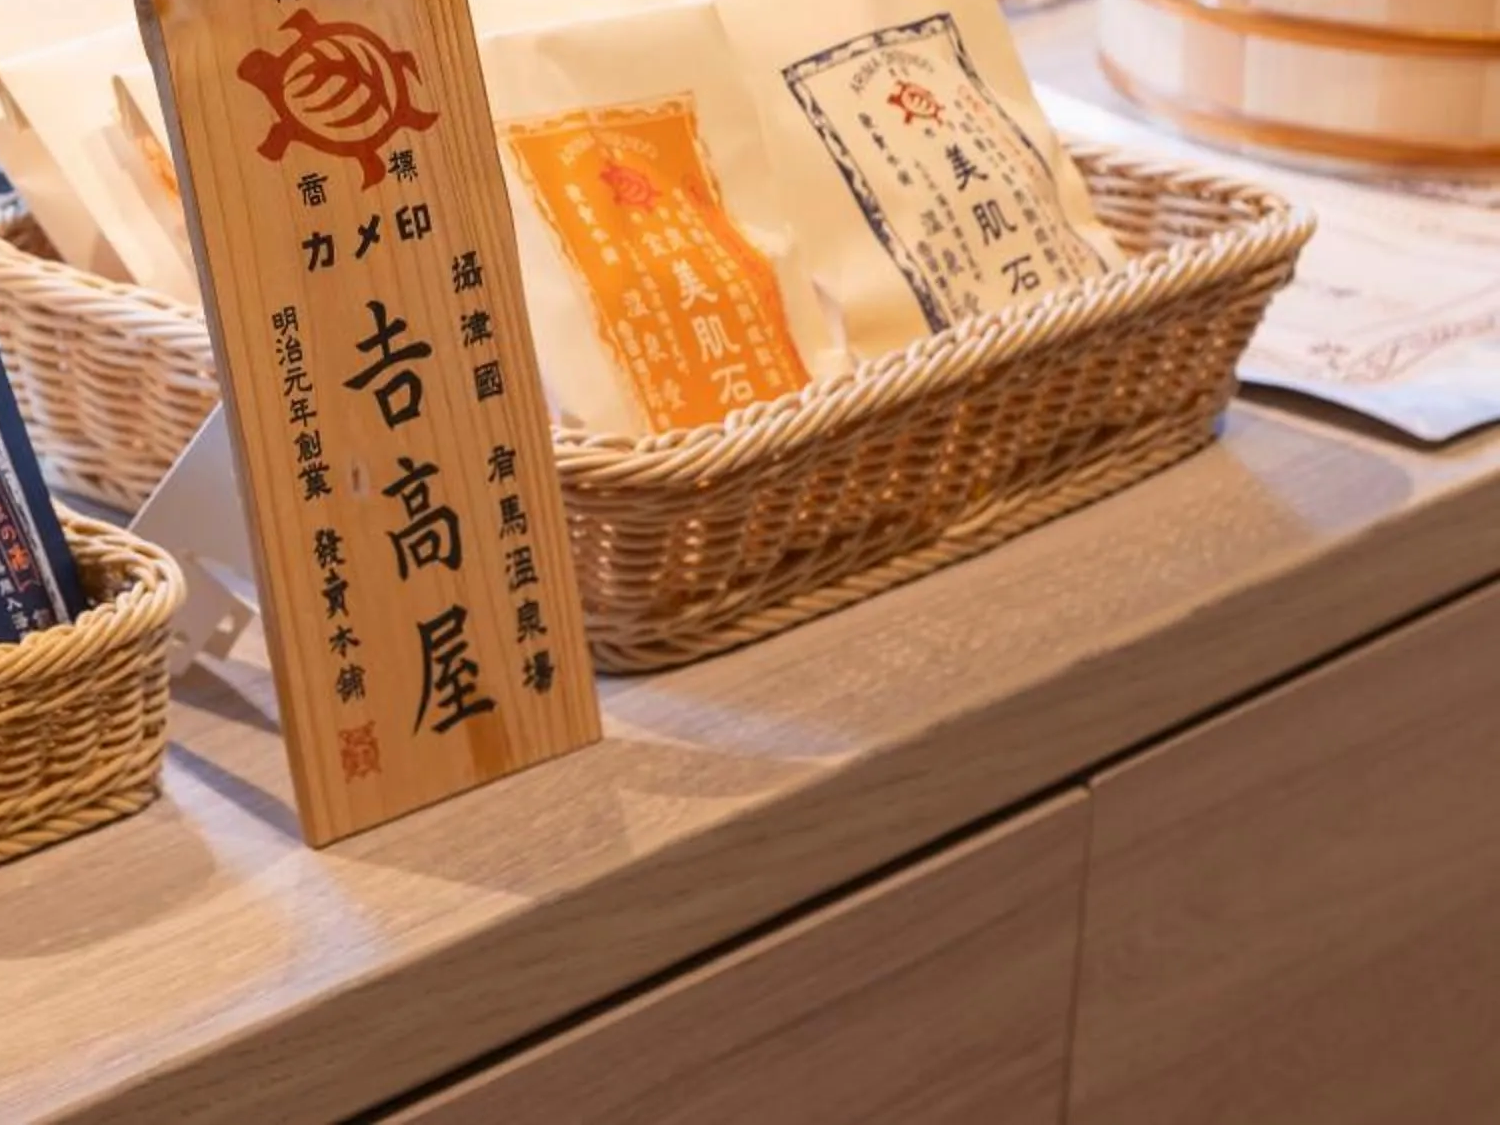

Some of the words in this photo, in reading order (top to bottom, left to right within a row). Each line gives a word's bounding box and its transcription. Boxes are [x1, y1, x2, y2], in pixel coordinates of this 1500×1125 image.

[301, 202, 433, 273] カメ印
[945, 144, 1040, 295] 美肌石
[271, 305, 333, 503] 明治元年創業
[671, 258, 754, 406] 美肌石
